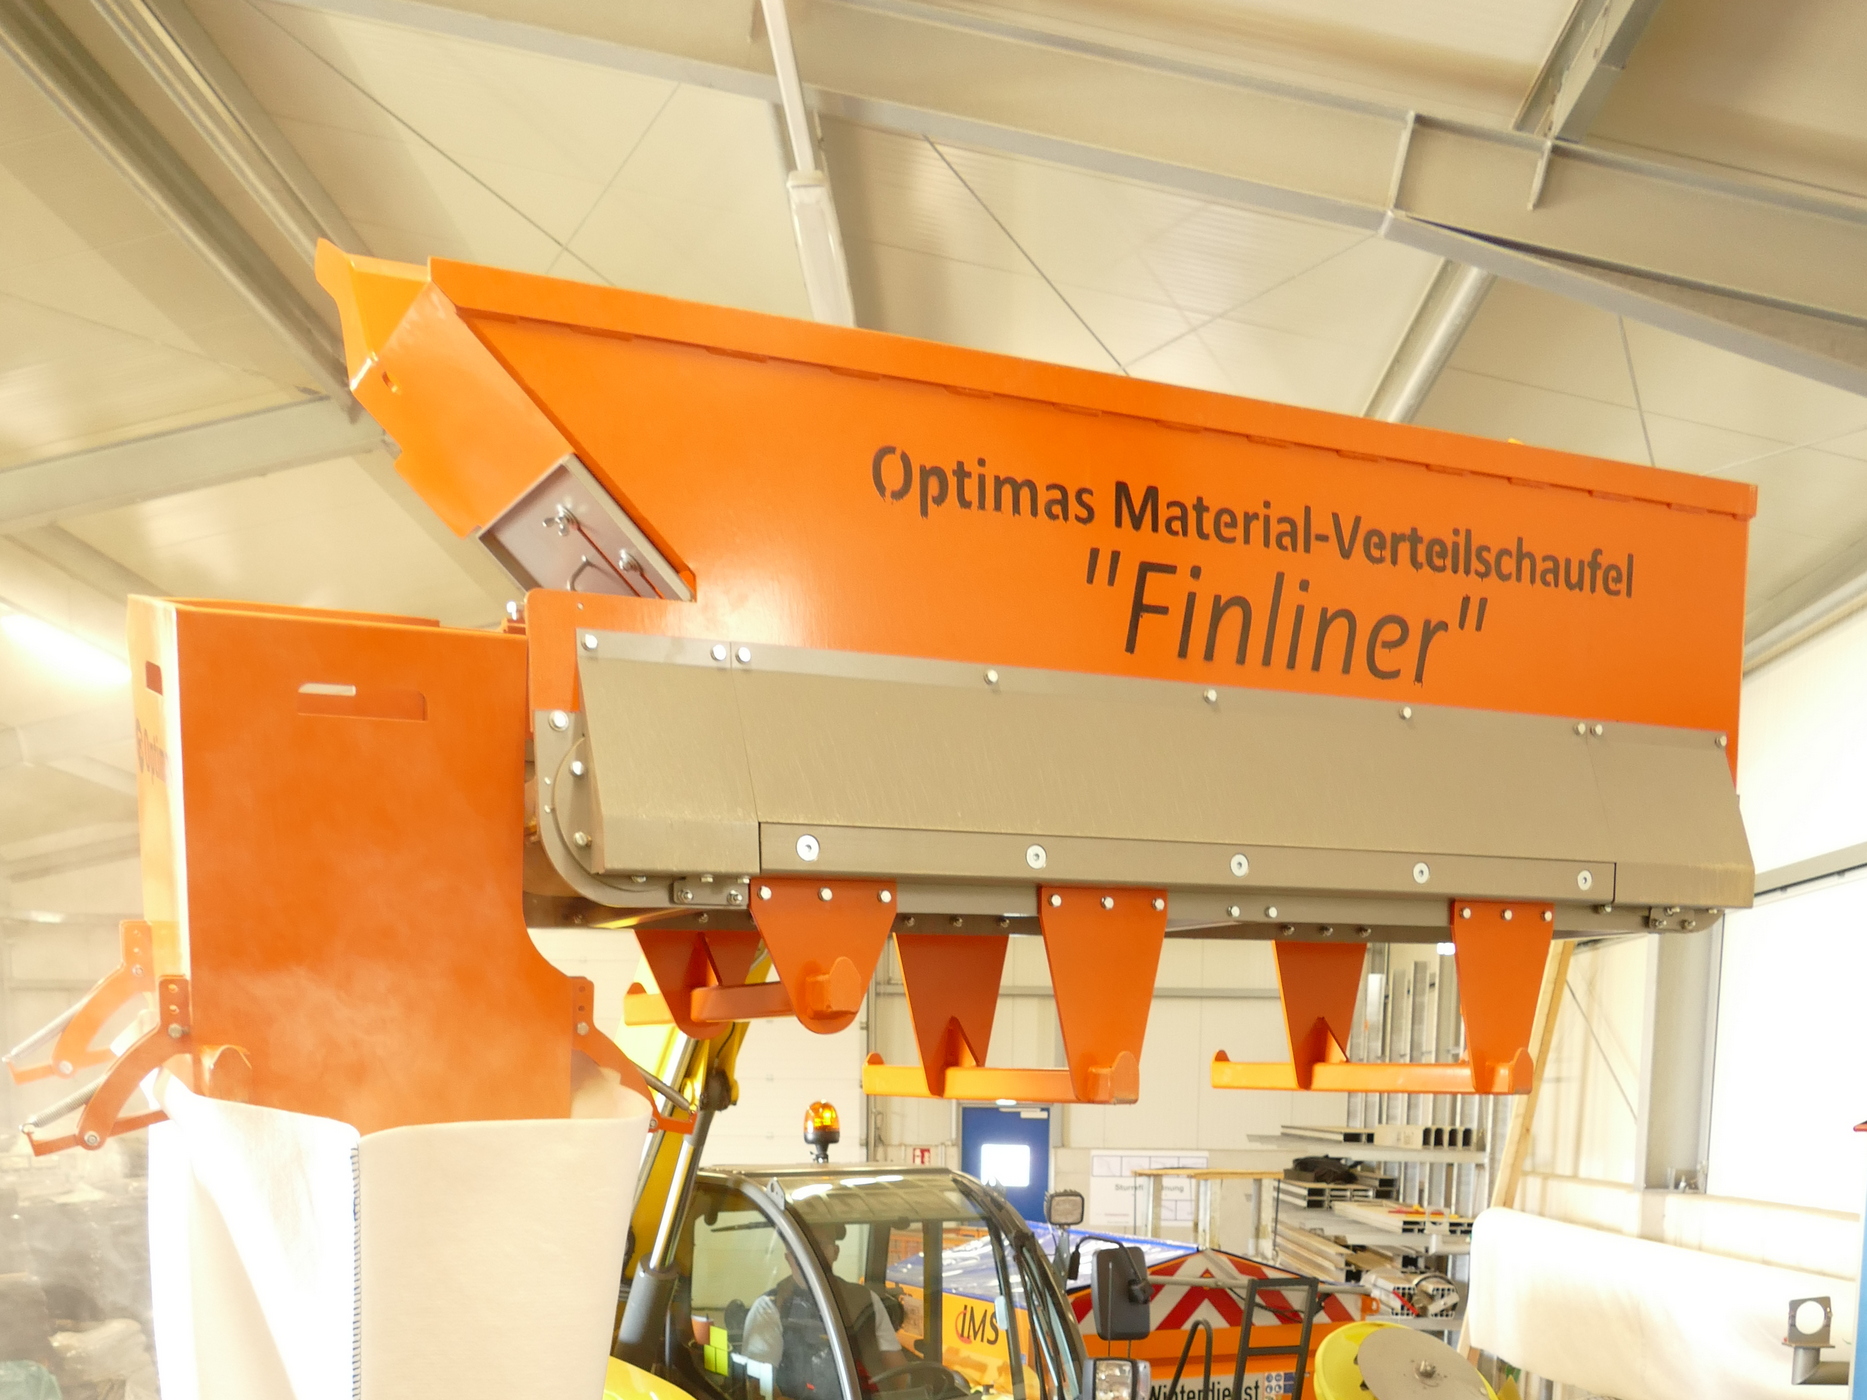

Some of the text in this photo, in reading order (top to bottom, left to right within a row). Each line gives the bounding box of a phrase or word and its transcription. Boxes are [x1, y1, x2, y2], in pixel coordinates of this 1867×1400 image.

[872, 445, 1634, 599] Optimas Material-Verteilschaufel
[1086, 547, 1488, 687] "Finliner"
